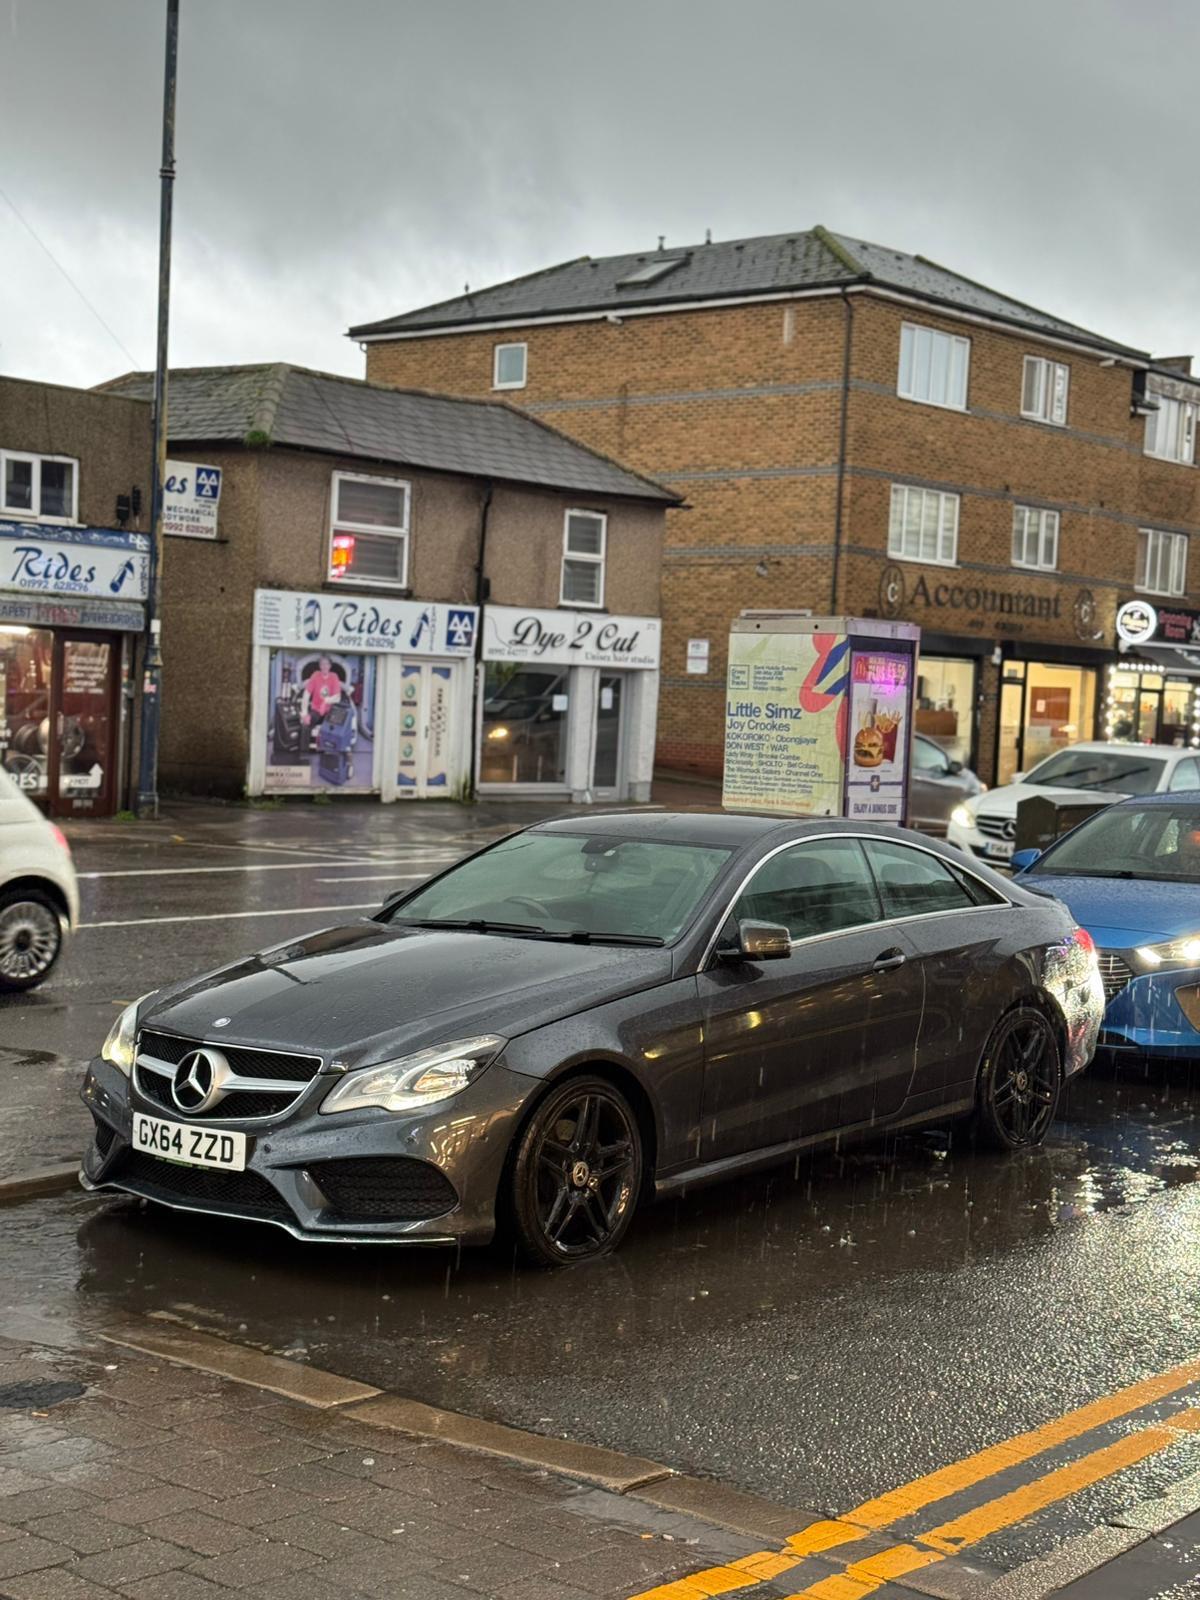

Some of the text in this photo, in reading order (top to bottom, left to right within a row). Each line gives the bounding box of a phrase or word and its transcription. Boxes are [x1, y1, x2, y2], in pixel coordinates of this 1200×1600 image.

[11, 546, 97, 583] Rides
[20, 579, 89, 592] 01992 628296
[910, 574, 1062, 618] Accountant
[331, 602, 403, 637] Rides
[337, 635, 363, 647] 01992
[509, 616, 640, 656] Dye 2 Cut
[585, 652, 655, 664] Unisex hair studio
[727, 701, 802, 720] Little Simz
[727, 718, 791, 732] Joy Crookes
[727, 732, 818, 746] KOKOROKO Obongjayar
[726, 741, 789, 753] DON WEST WAR
[853, 803, 868, 814] ENJOY
[140, 1118, 234, 1164] GX64 ZZD
